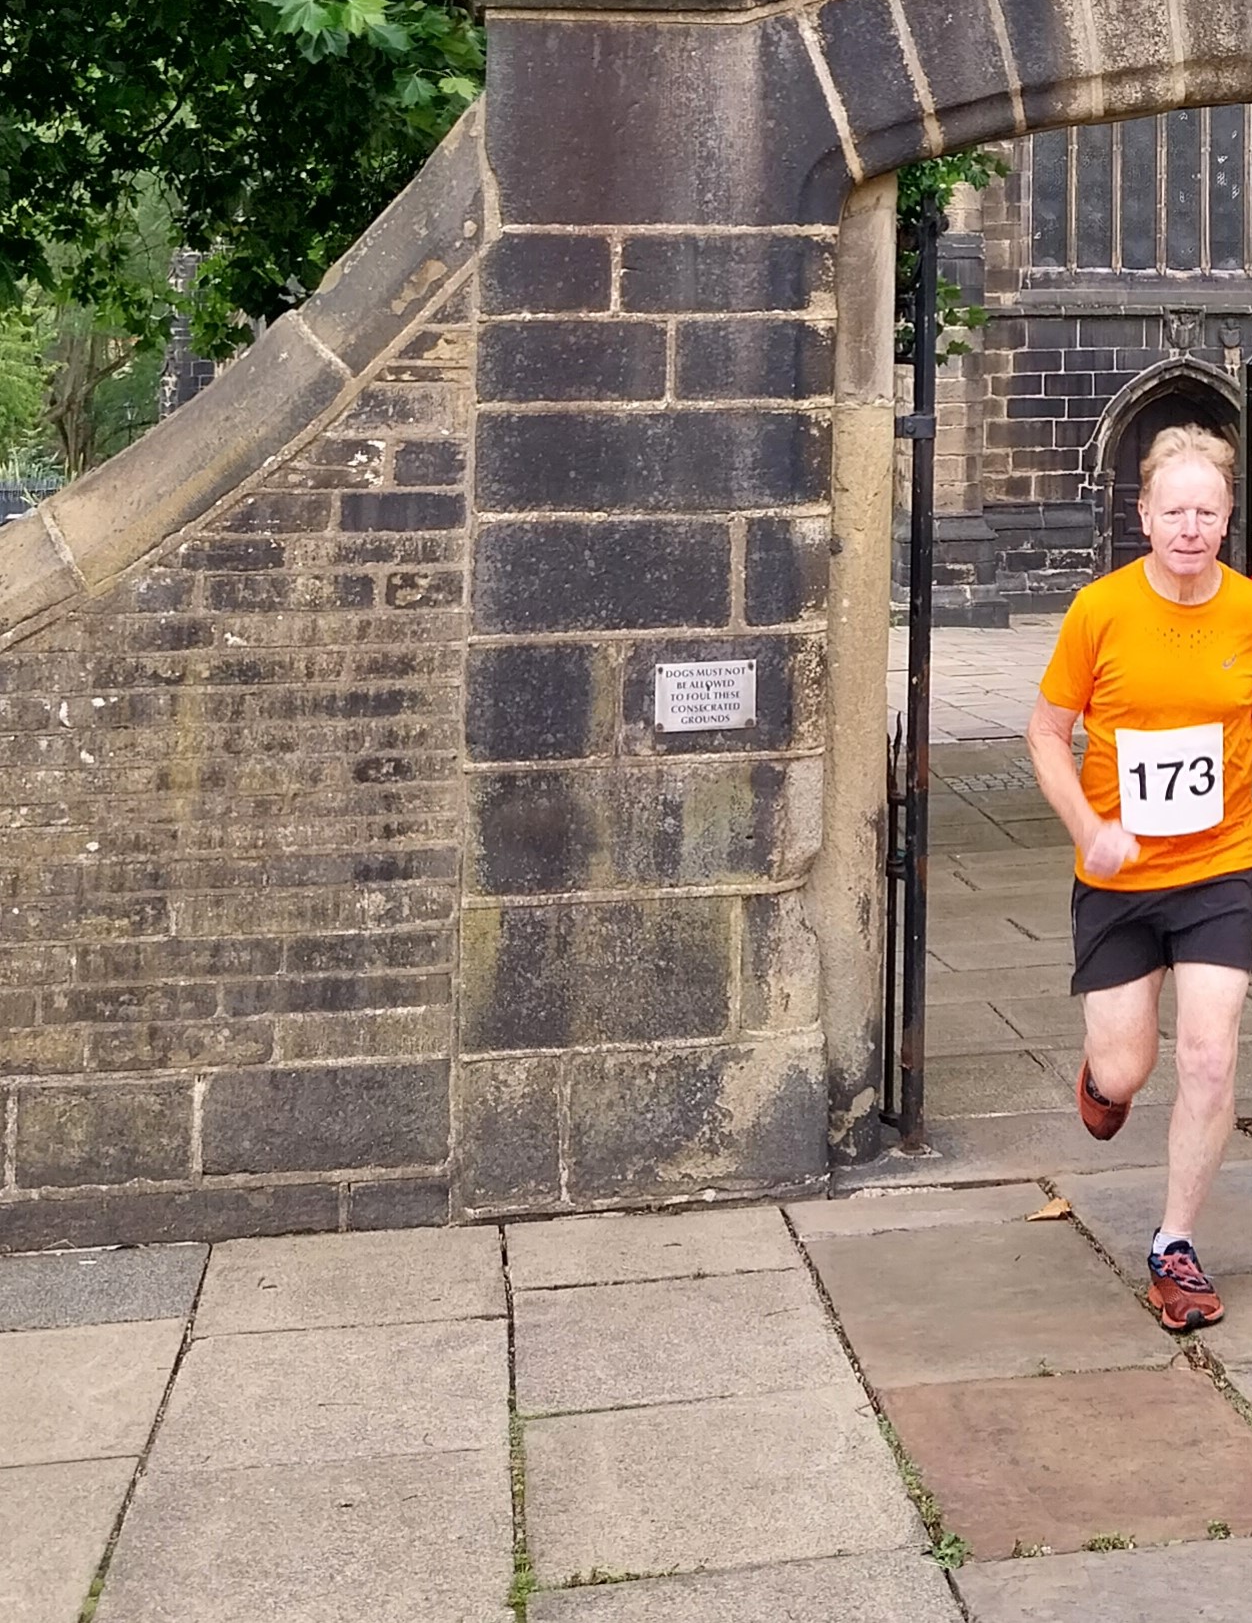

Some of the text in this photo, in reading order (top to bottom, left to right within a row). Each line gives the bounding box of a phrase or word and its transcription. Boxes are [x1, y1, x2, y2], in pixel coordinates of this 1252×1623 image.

[665, 666, 746, 678] DOGS MUST NOT
[676, 679, 735, 690] BE ALLOWED
[671, 690, 740, 702] TO FOUL THESE
[670, 702, 741, 713] CONSECRATED
[680, 714, 731, 724] GROUNDS
[1129, 755, 1216, 802] 173
